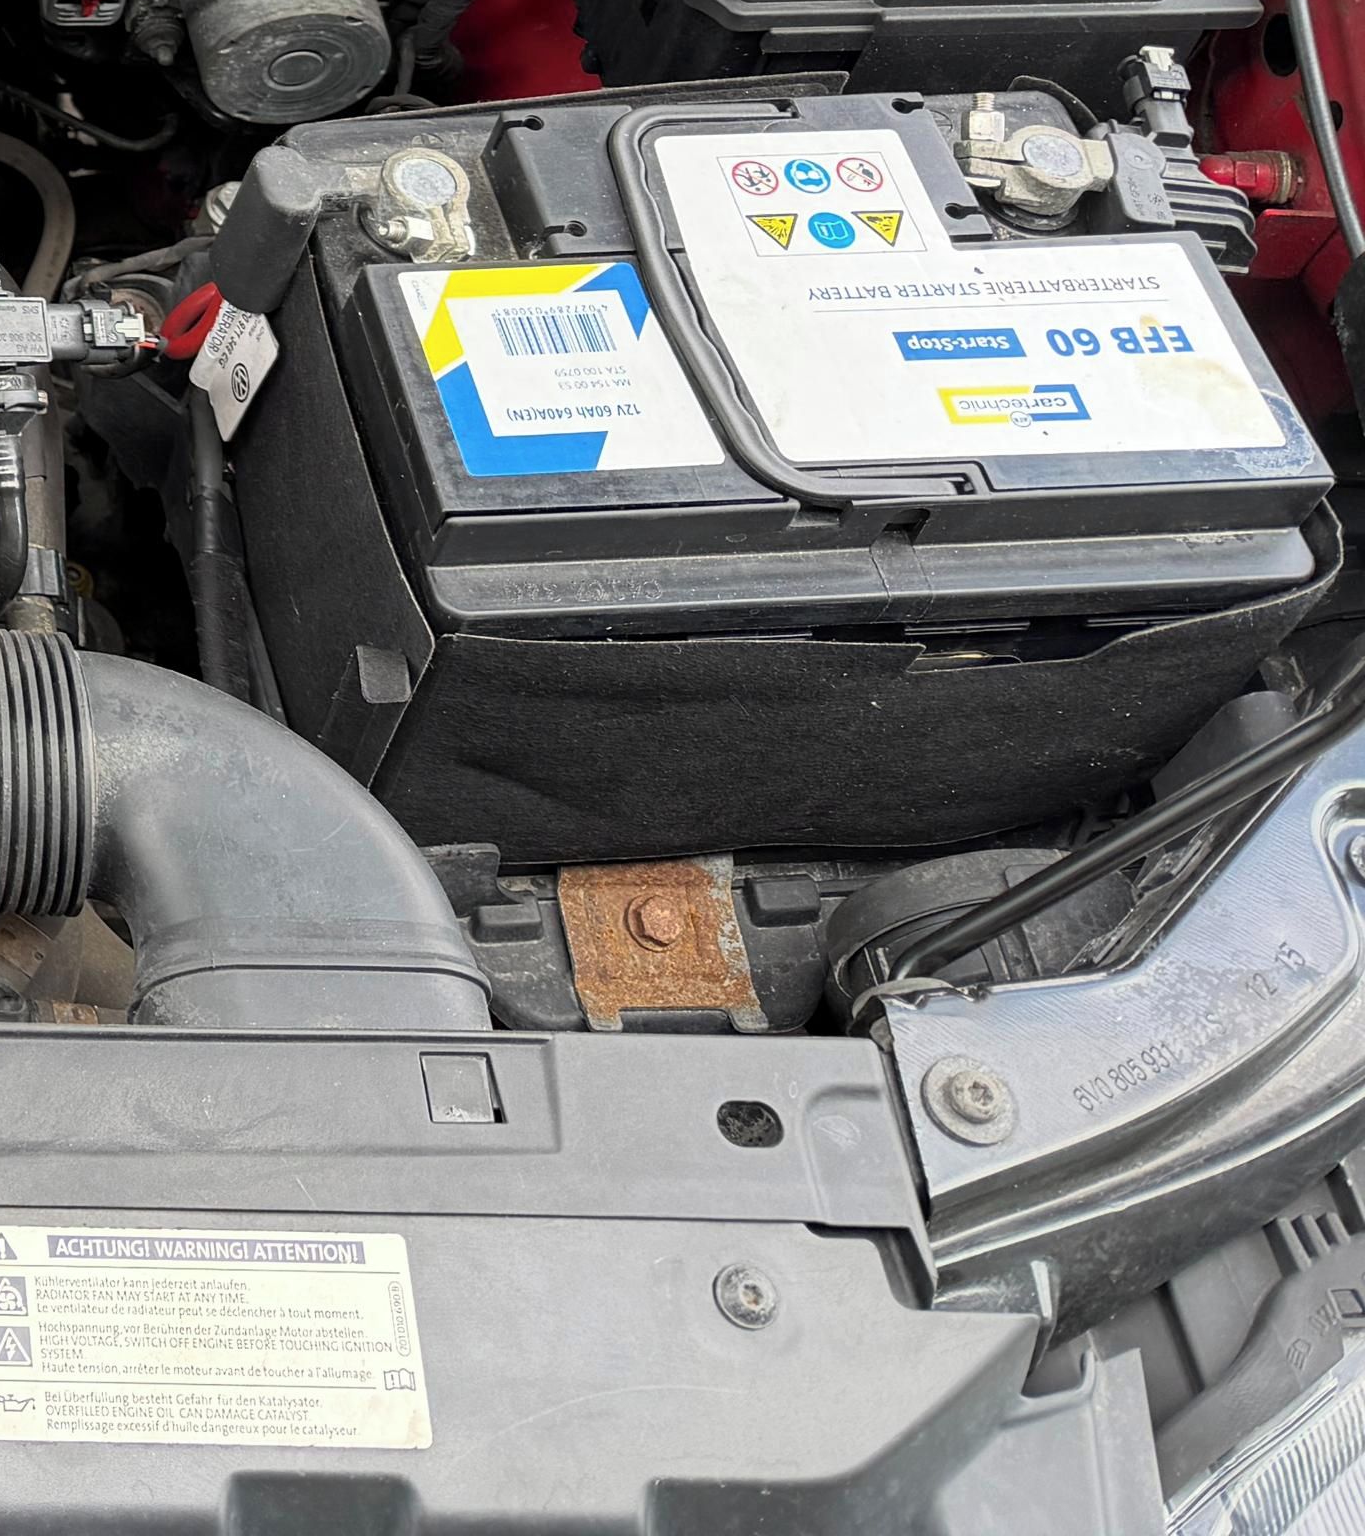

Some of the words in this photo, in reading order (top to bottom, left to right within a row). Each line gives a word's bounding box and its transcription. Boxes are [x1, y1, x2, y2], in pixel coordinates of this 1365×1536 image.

[807, 285, 889, 301] BATTERY
[892, 282, 980, 298] STARTER
[984, 275, 1160, 296] STARTERBATTERIE
[15, 344, 29, 353] AG
[906, 333, 1011, 353] Start-Stop
[1045, 327, 1100, 357] 60
[1109, 325, 1195, 355] EFB
[582, 366, 602, 376] 100
[604, 365, 627, 376] STA
[574, 380, 588, 390] 00
[590, 379, 611, 389] 154
[613, 378, 631, 389] MA
[506, 406, 572, 422] 640A(EN)
[576, 405, 612, 418] 60Ah
[616, 403, 641, 416] 12V
[958, 396, 1067, 415] cartechnic
[1245, 973, 1279, 1002] 12
[1107, 1058, 1150, 1098] 805
[55, 1238, 150, 1258] ACHTUNG!
[154, 1239, 249, 1261] WARNING!
[253, 1242, 359, 1264] ATTENTION!
[34, 1276, 121, 1289] Kühlerventilator
[123, 1277, 149, 1289] kann
[151, 1278, 197, 1293] jederzeit
[35, 1288, 90, 1301] RADIATOR
[92, 1289, 113, 1301] FAN
[117, 1290, 142, 1302] MAY
[144, 1290, 175, 1302] START
[177, 1291, 192, 1302] AT
[194, 1292, 217, 1304] ANY
[37, 1303, 49, 1313] Le
[51, 1302, 108, 1314] ventilateur
[111, 1303, 125, 1315] de
[127, 1303, 176, 1315] radiateur
[179, 1305, 204, 1319] peut
[206, 1308, 218, 1318] se
[220, 1306, 277, 1319] déclencher
[288, 1308, 311, 1320] tout
[314, 1309, 364, 1321] moment.
[123, 1324, 141, 1335] vor
[143, 1322, 192, 1336] Berühren
[194, 1325, 212, 1337] der
[214, 1324, 278, 1340] Zündanlage
[279, 1326, 314, 1338] Motor
[39, 1335, 68, 1347] HIGH
[72, 1335, 123, 1348] VOLTAGE,
[125, 1336, 167, 1349] SWITCH
[169, 1337, 190, 1349] OFF
[192, 1338, 234, 1350] ENGINE
[236, 1338, 277, 1351] BEFORE
[279, 1340, 339, 1353] TOUCHING
[341, 1341, 393, 1354] IGNITION
[42, 1361, 76, 1374] Haute
[78, 1362, 121, 1376] tension,
[123, 1363, 158, 1375] arrêter
[174, 1365, 213, 1377] moteur
[215, 1366, 246, 1378] avant
[248, 1366, 262, 1378] de
[263, 1366, 305, 1379] toucher
[45, 1392, 61, 1403] Bei
[64, 1390, 130, 1407] Überfüllung
[132, 1392, 173, 1405] besteht
[176, 1393, 212, 1407] Gefahr
[217, 1394, 233, 1407] für
[236, 1395, 257, 1407] den
[46, 1405, 110, 1418] OVERFILLED
[112, 1406, 154, 1418] ENGINE
[156, 1406, 175, 1418] OIL
[179, 1407, 203, 1420] CAN
[206, 1408, 256, 1421] DAMAGE
[47, 1419, 115, 1434] Remplissage
[117, 1420, 160, 1433] excessif
[162, 1421, 199, 1434] d'huile
[201, 1422, 259, 1437] dangereux
[262, 1425, 287, 1438] pour
